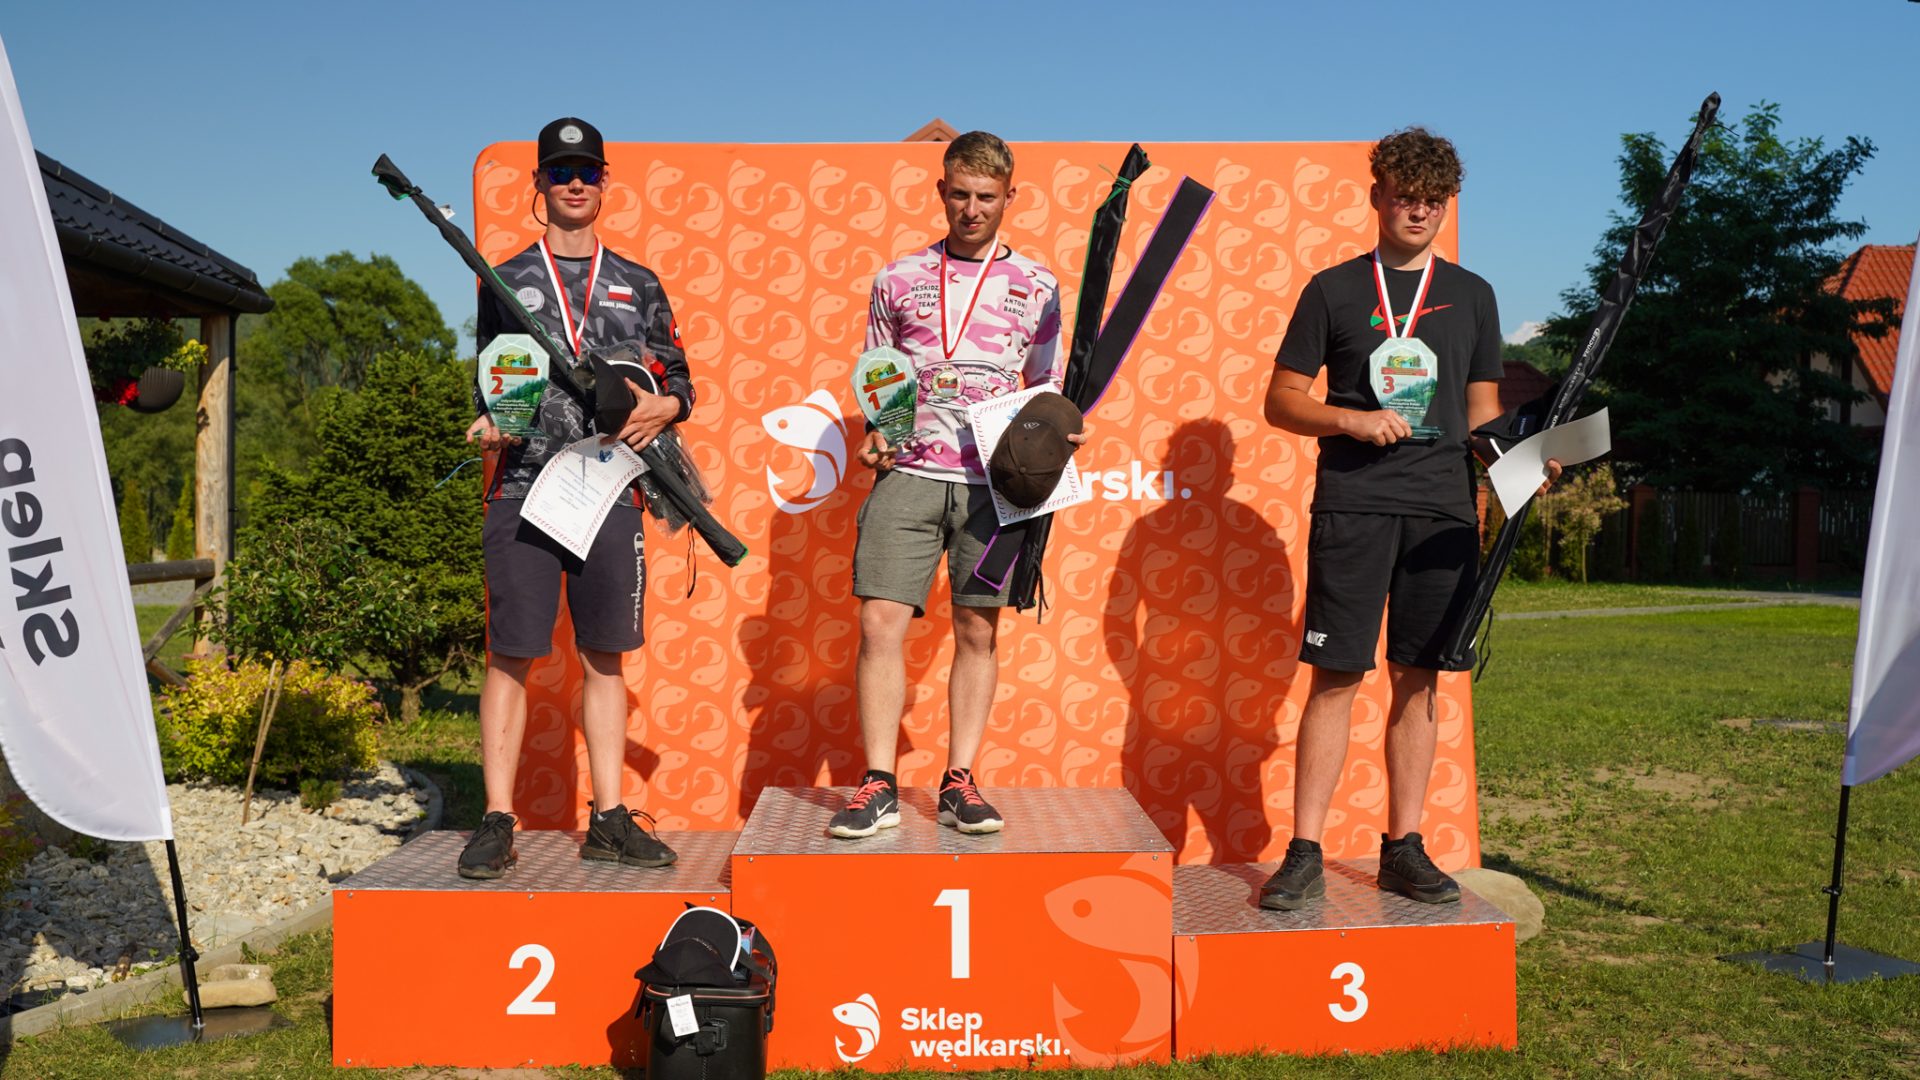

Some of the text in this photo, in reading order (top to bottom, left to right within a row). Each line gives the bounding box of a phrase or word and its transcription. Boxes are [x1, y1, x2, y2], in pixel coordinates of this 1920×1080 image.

[1003, 305, 1025, 318] BABICZ
[1004, 297, 1027, 310] ANTONI
[490, 375, 504, 395] 2
[1382, 375, 1395, 394] 3
[867, 391, 881, 411] 1
[1081, 460, 1192, 501] rski.
[0, 437, 80, 667] Sklep
[631, 532, 645, 632] Champion
[1305, 629, 1328, 647] NIKE
[932, 888, 970, 979] 1
[506, 943, 556, 1015] 2
[1327, 961, 1369, 1023] 3
[900, 1007, 983, 1035] Sklep
[910, 1033, 1071, 1063] wędkarski.
